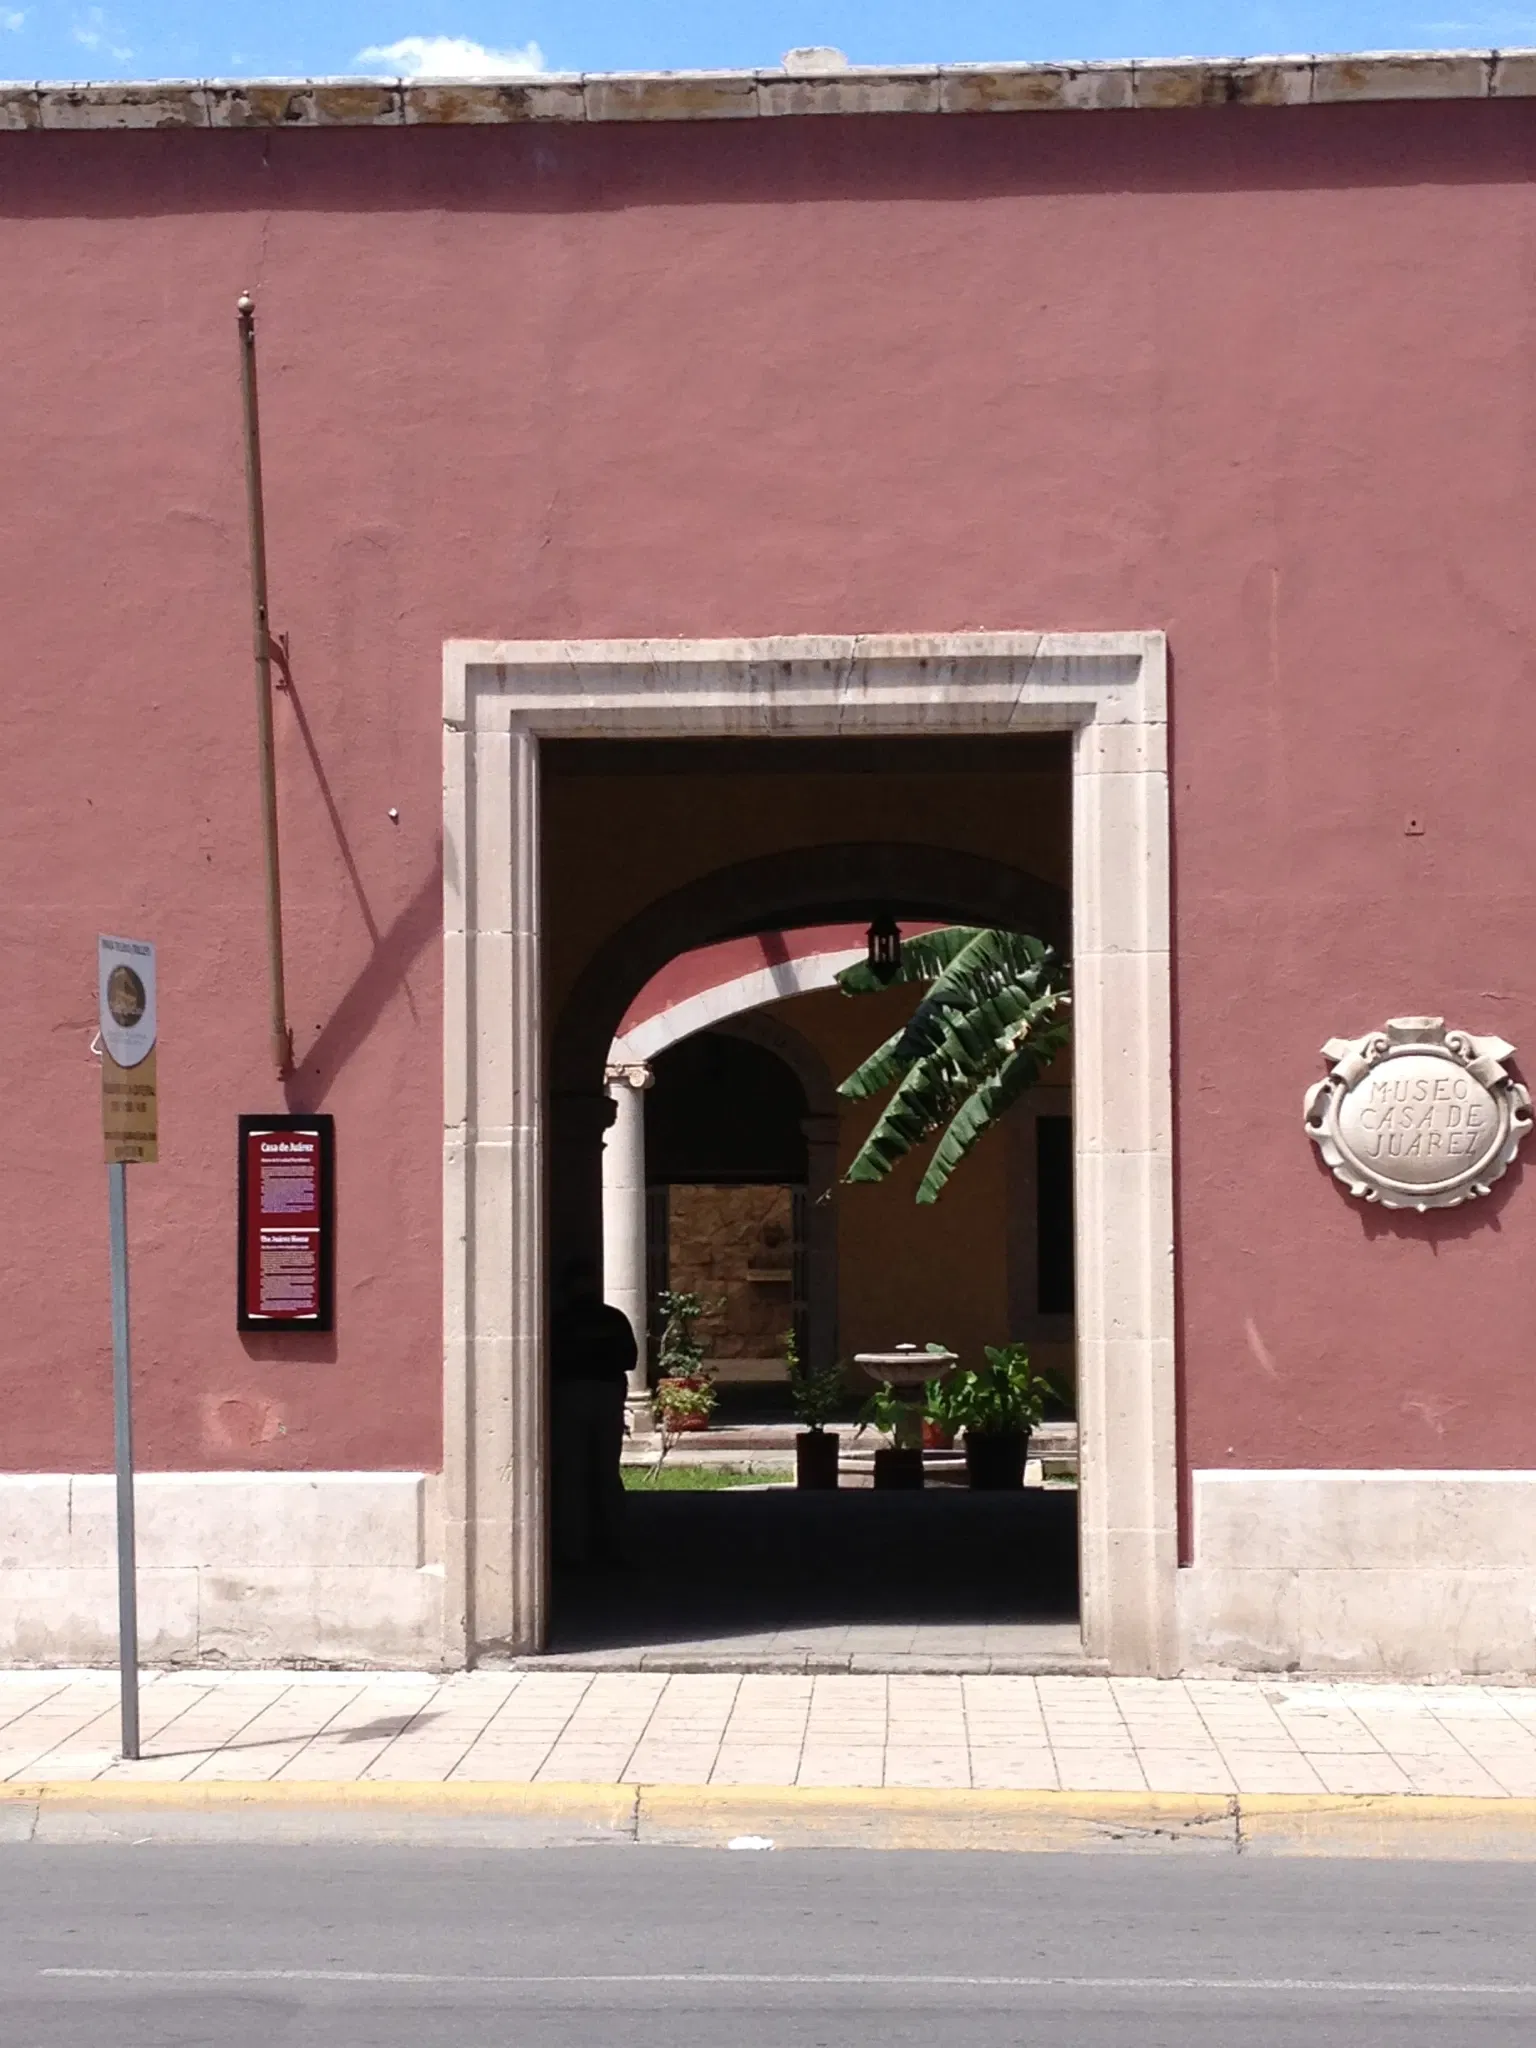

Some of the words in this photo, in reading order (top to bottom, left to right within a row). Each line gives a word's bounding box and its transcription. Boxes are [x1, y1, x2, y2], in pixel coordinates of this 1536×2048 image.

[1370, 1078, 1468, 1103] MUSEO
[1360, 1106, 1435, 1130] CASA
[1446, 1104, 1486, 1128] DE
[261, 1142, 278, 1152] Casa
[279, 1142, 289, 1152] de
[290, 1141, 314, 1152] Juárez
[1366, 1131, 1479, 1157] JUAREZ
